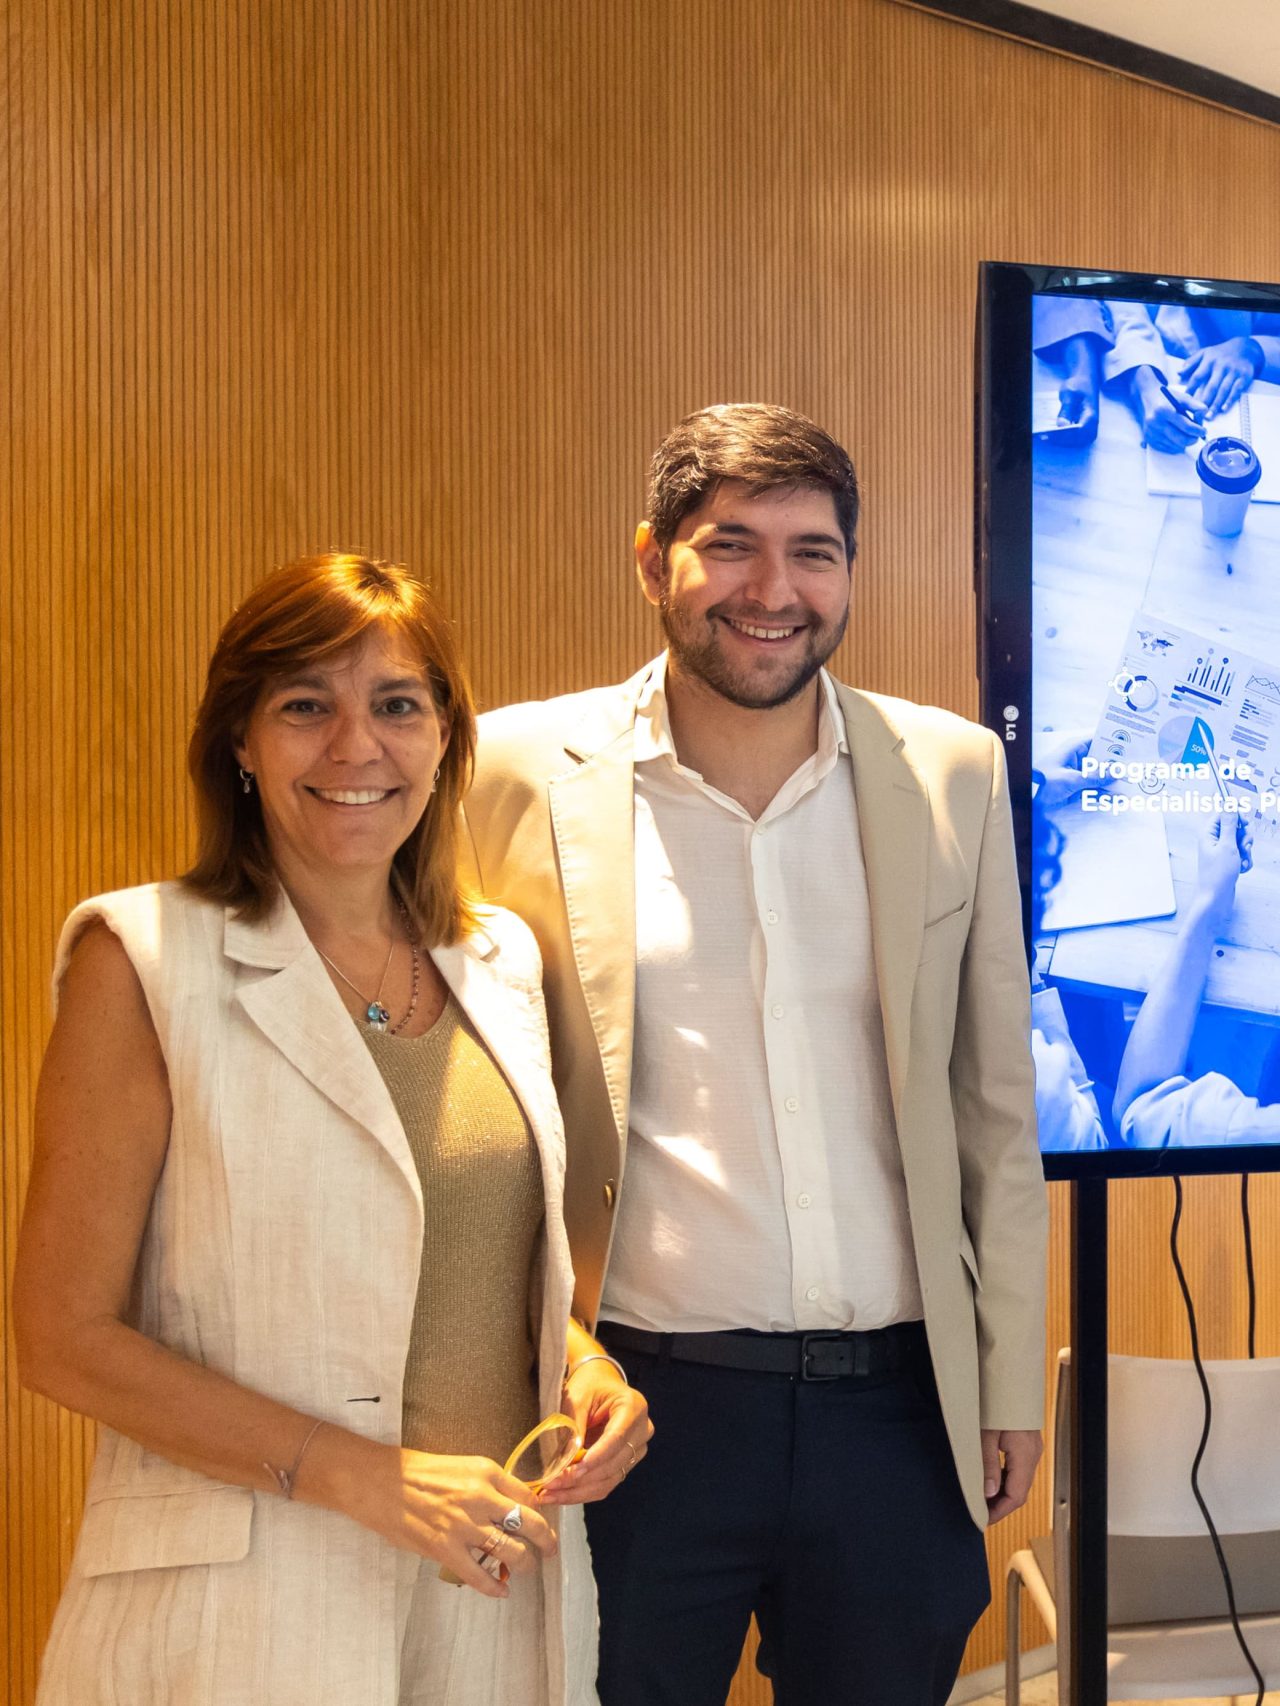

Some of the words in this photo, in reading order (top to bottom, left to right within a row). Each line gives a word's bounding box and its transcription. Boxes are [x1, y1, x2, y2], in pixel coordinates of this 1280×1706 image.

[1005, 723, 1017, 741] LG
[1081, 757, 1210, 782] Programa
[1218, 757, 1252, 780] de
[1081, 790, 1252, 815] Especialistas
